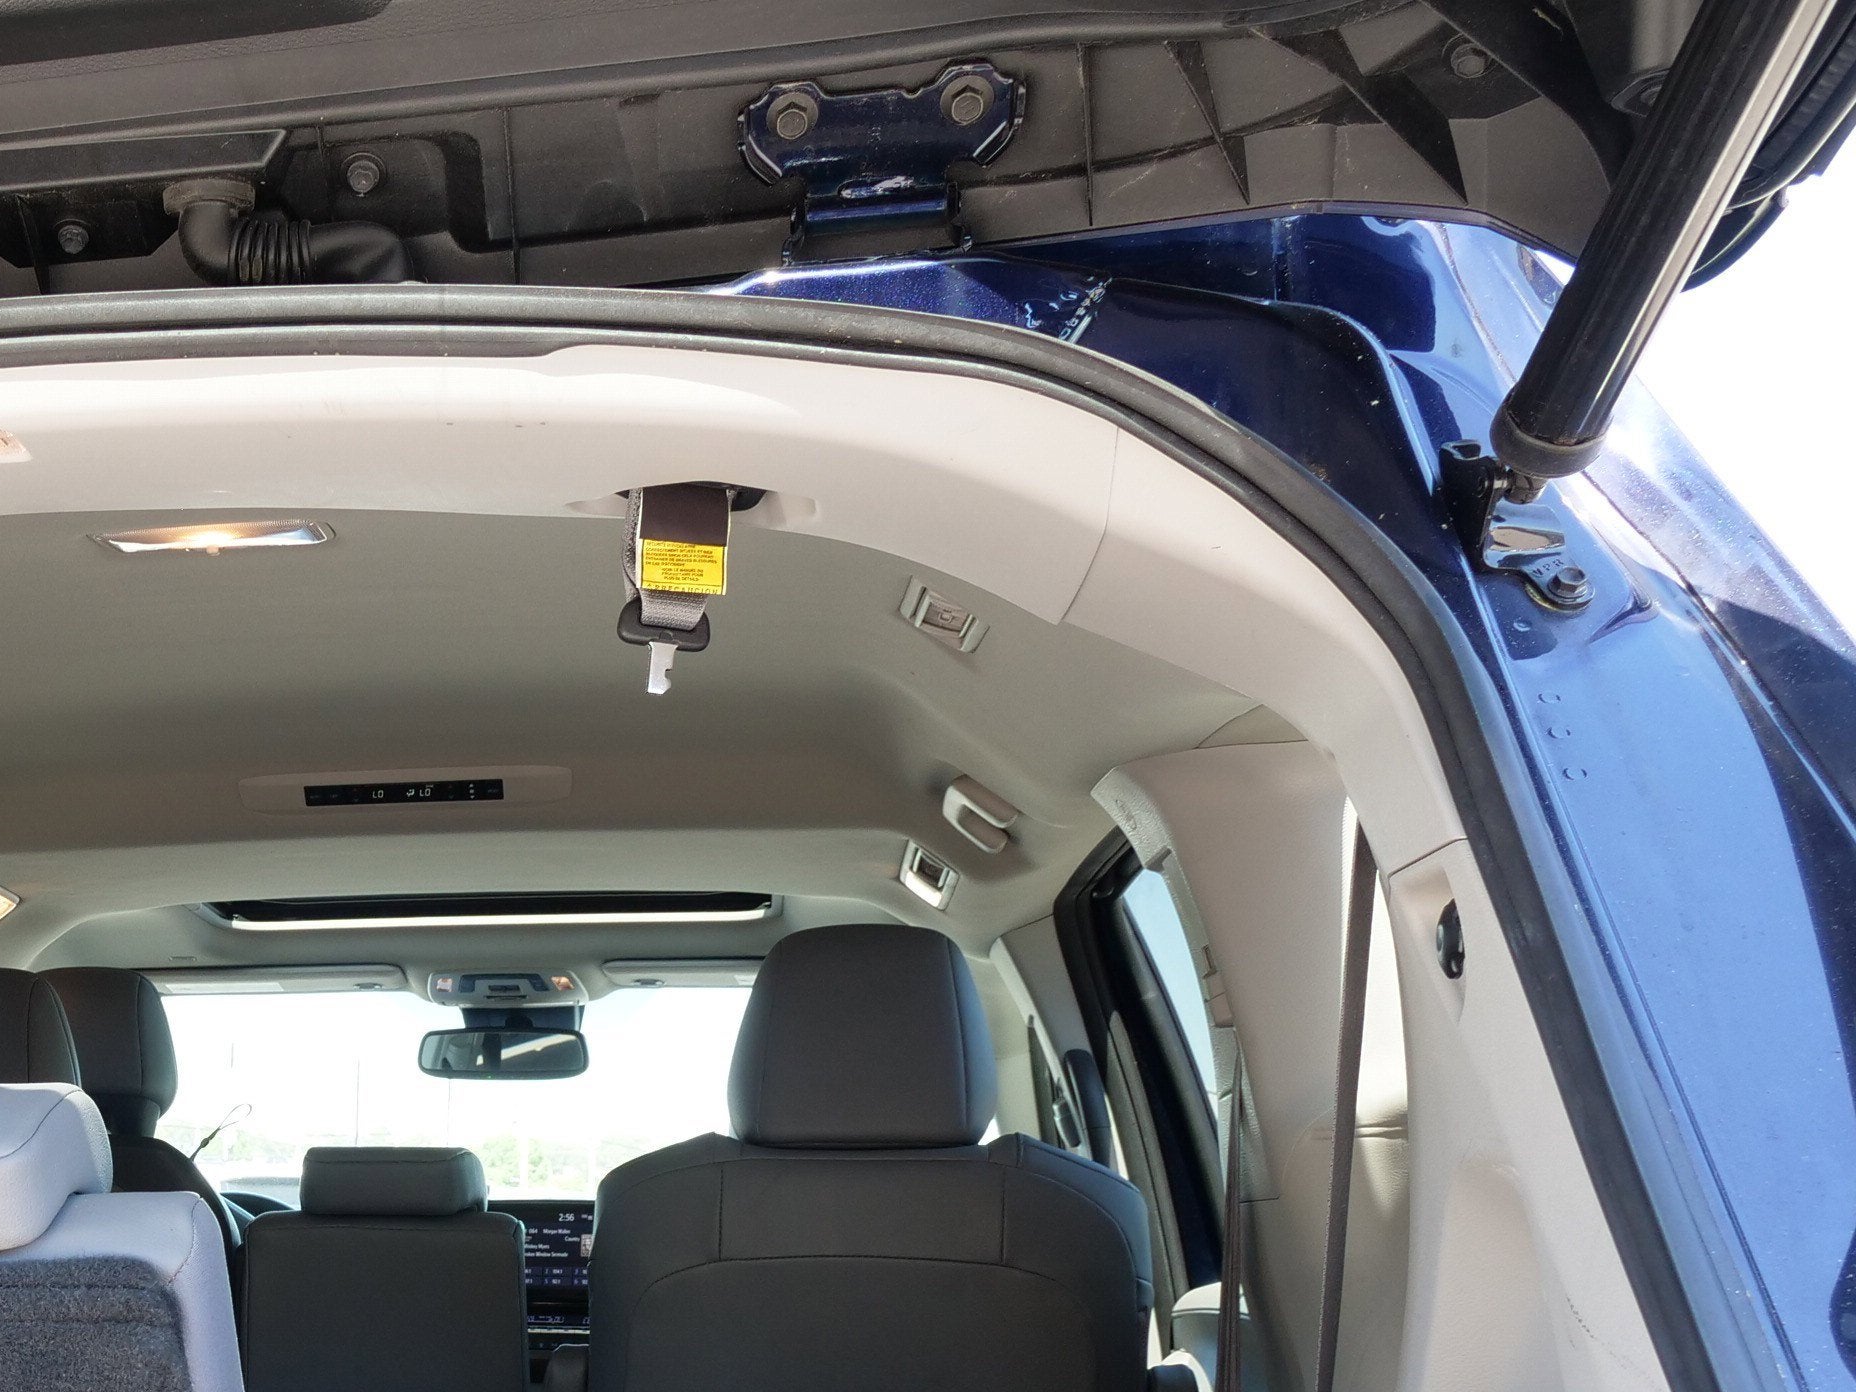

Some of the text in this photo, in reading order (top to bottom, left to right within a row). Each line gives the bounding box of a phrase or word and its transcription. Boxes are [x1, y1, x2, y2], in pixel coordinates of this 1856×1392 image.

[372, 790, 384, 798] LO
[420, 788, 431, 797] LO
[558, 1213, 574, 1222] 2:56
